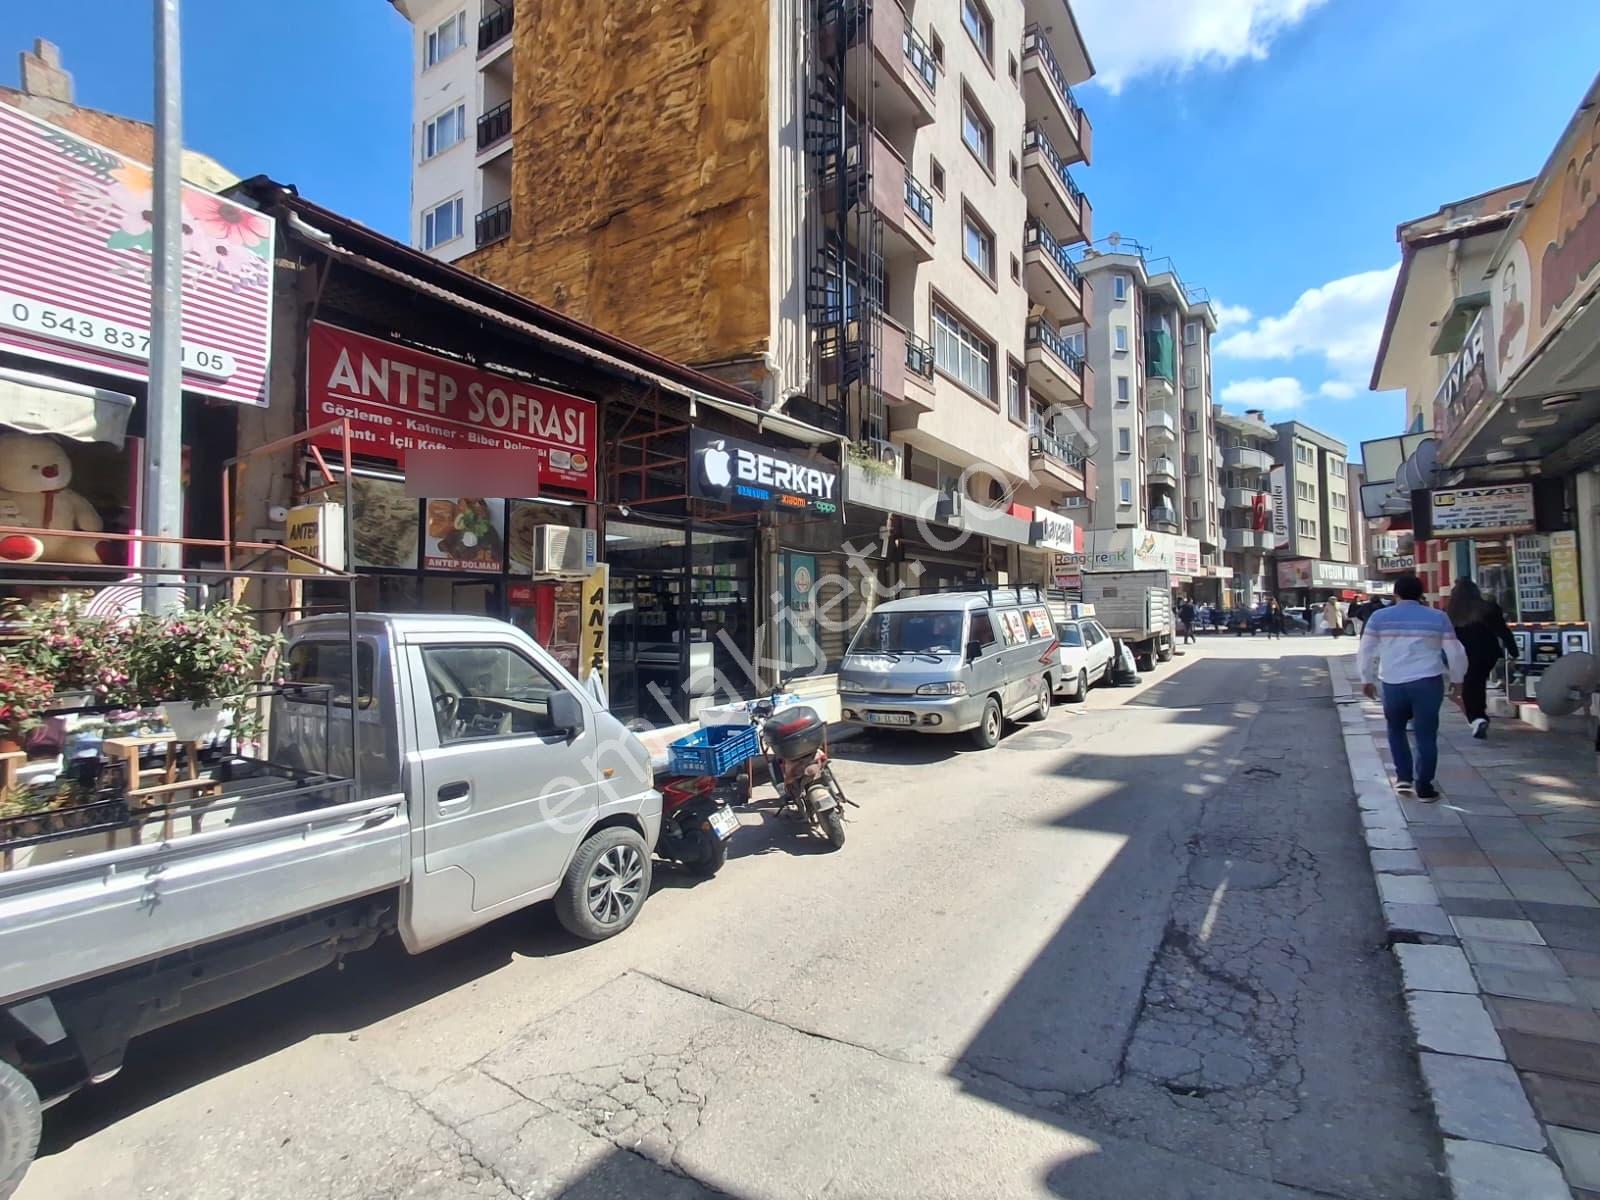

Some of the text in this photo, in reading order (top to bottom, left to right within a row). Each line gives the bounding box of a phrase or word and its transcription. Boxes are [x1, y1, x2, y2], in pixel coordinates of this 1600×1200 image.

[12, 303, 29, 322] 0
[41, 311, 94, 338] 543
[104, 327, 150, 352] 837
[196, 351, 223, 371] 05
[1444, 325, 1484, 407] UYAR
[327, 346, 585, 446] ANTEP SOFRASI
[321, 401, 393, 426] Gözleme
[406, 418, 457, 438] Katmer
[467, 432, 502, 448] Biber
[389, 432, 414, 450] İçli
[737, 449, 836, 499] BERKAY
[428, 558, 501, 571] ANTEP DOLMASI
